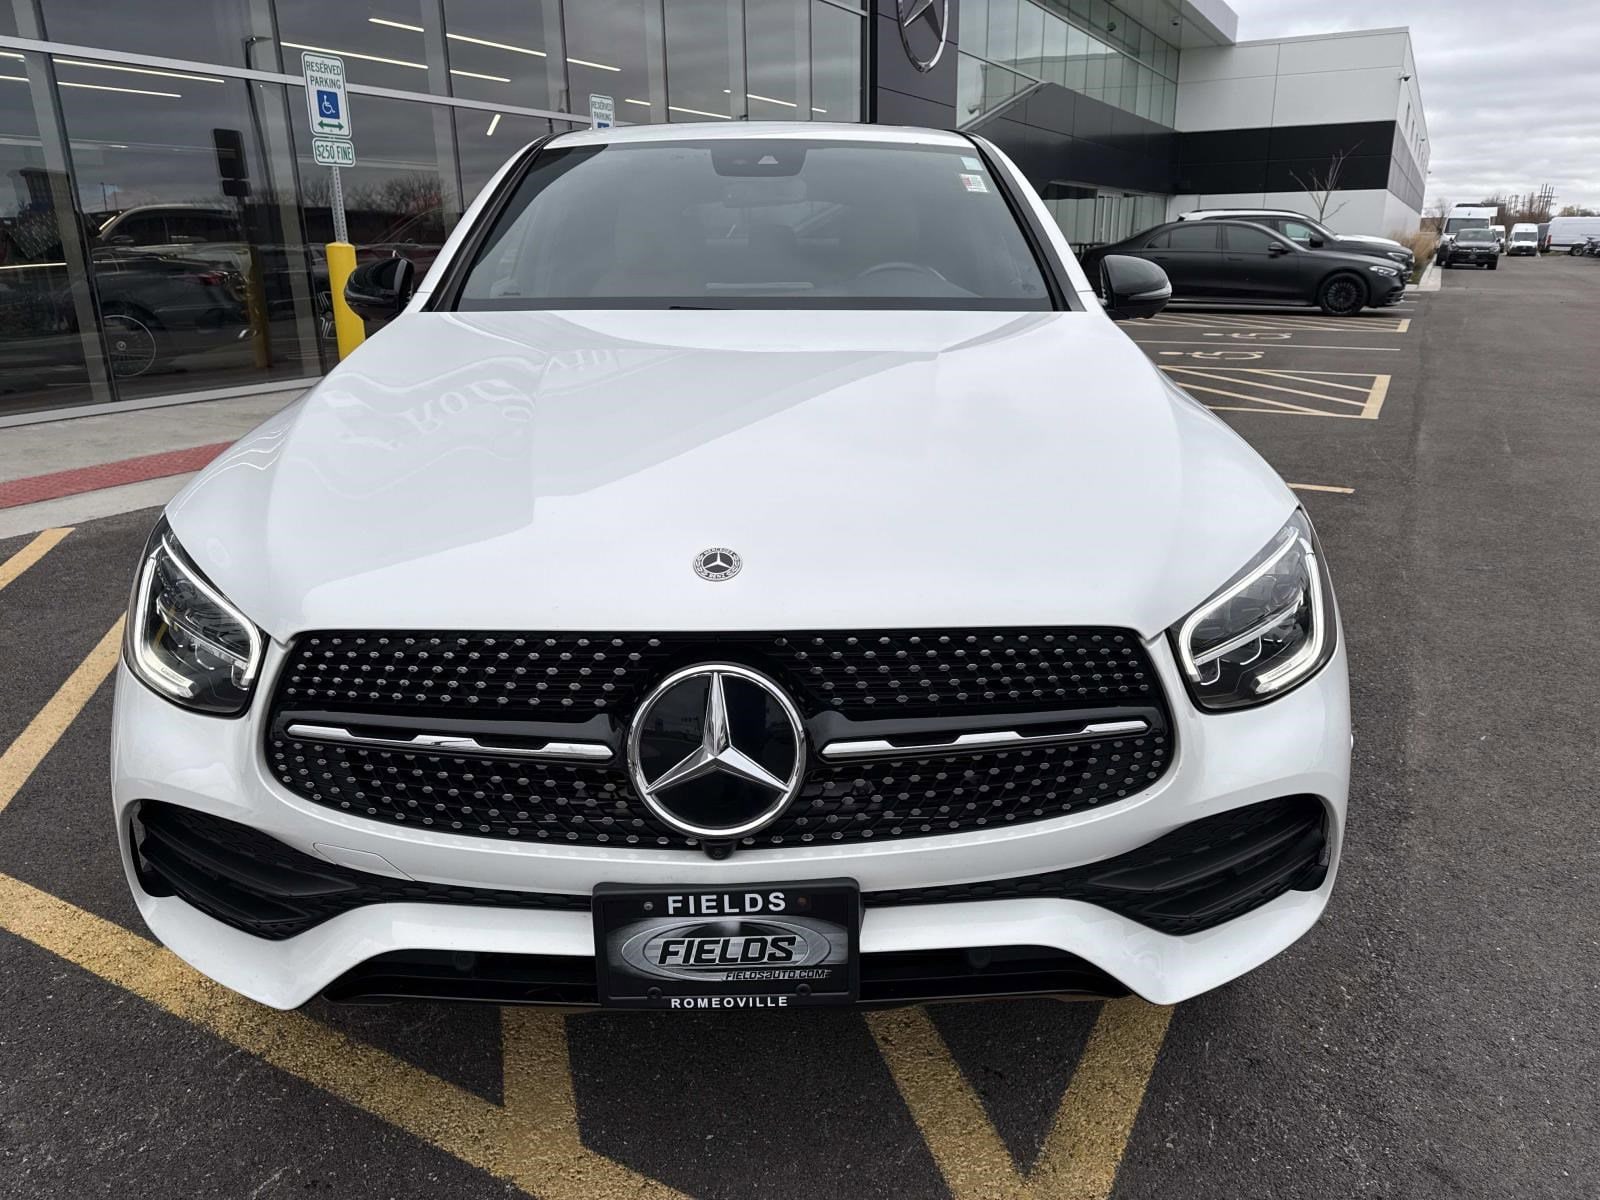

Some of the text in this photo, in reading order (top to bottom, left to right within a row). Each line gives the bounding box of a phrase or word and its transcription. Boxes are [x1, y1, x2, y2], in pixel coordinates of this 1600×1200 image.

[305, 60, 342, 76] RESERVED
[310, 75, 342, 89] PARKING
[316, 144, 353, 161] $250 FINE
[667, 891, 786, 915] FIELDS
[658, 936, 796, 965] FIELDS
[671, 996, 788, 1009] ROMEOVILLE
